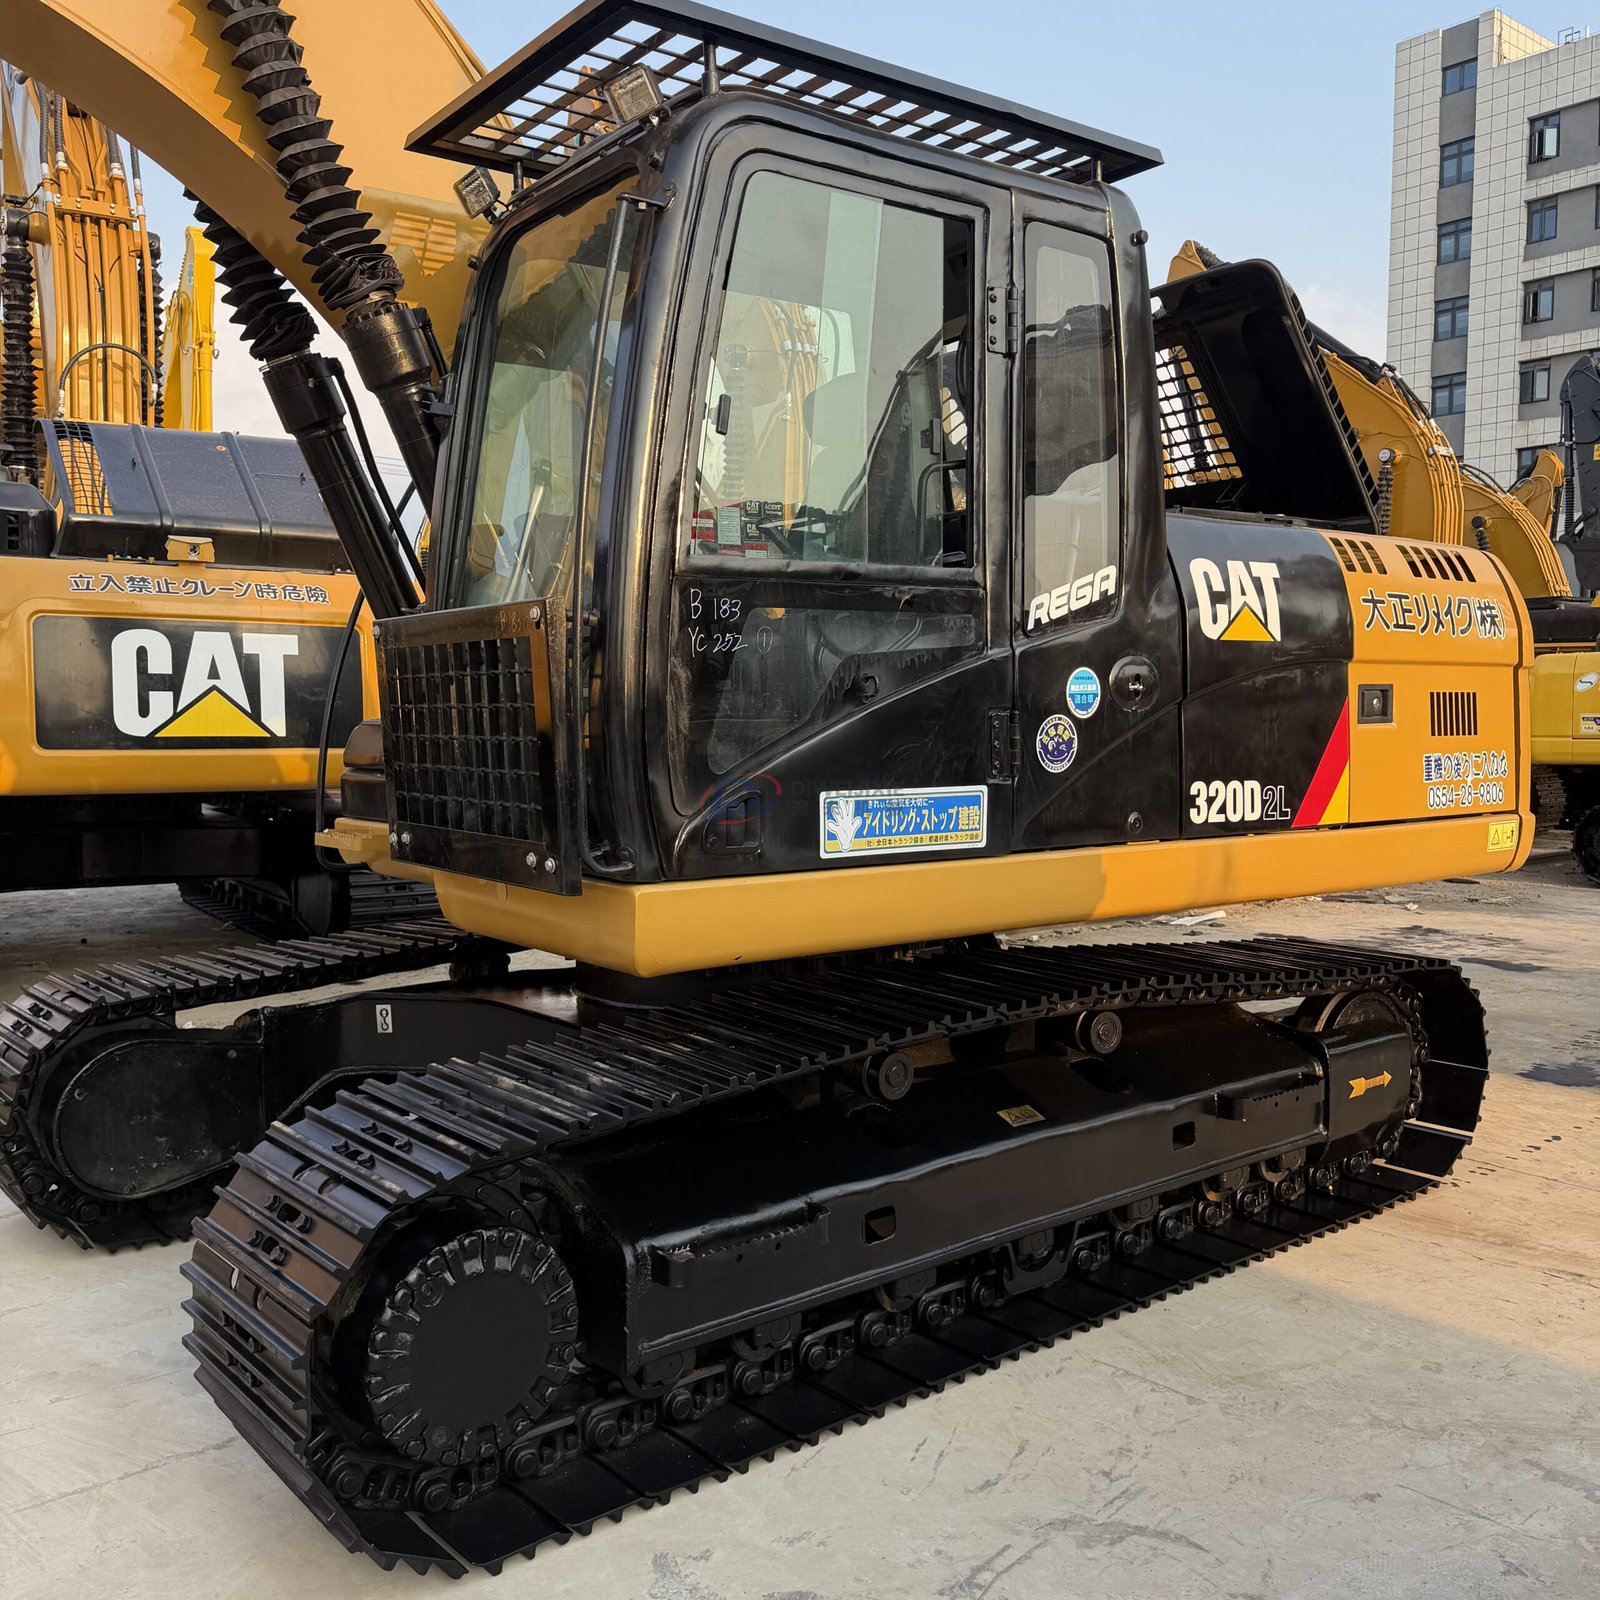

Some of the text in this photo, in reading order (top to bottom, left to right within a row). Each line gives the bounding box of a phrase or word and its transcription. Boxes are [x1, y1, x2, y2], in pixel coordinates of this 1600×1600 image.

[746, 501, 760, 511] CAT
[690, 588, 742, 622] B 183
[1027, 565, 1117, 630] REGA
[1189, 557, 1281, 642] CAT
[111, 628, 299, 738] CAT
